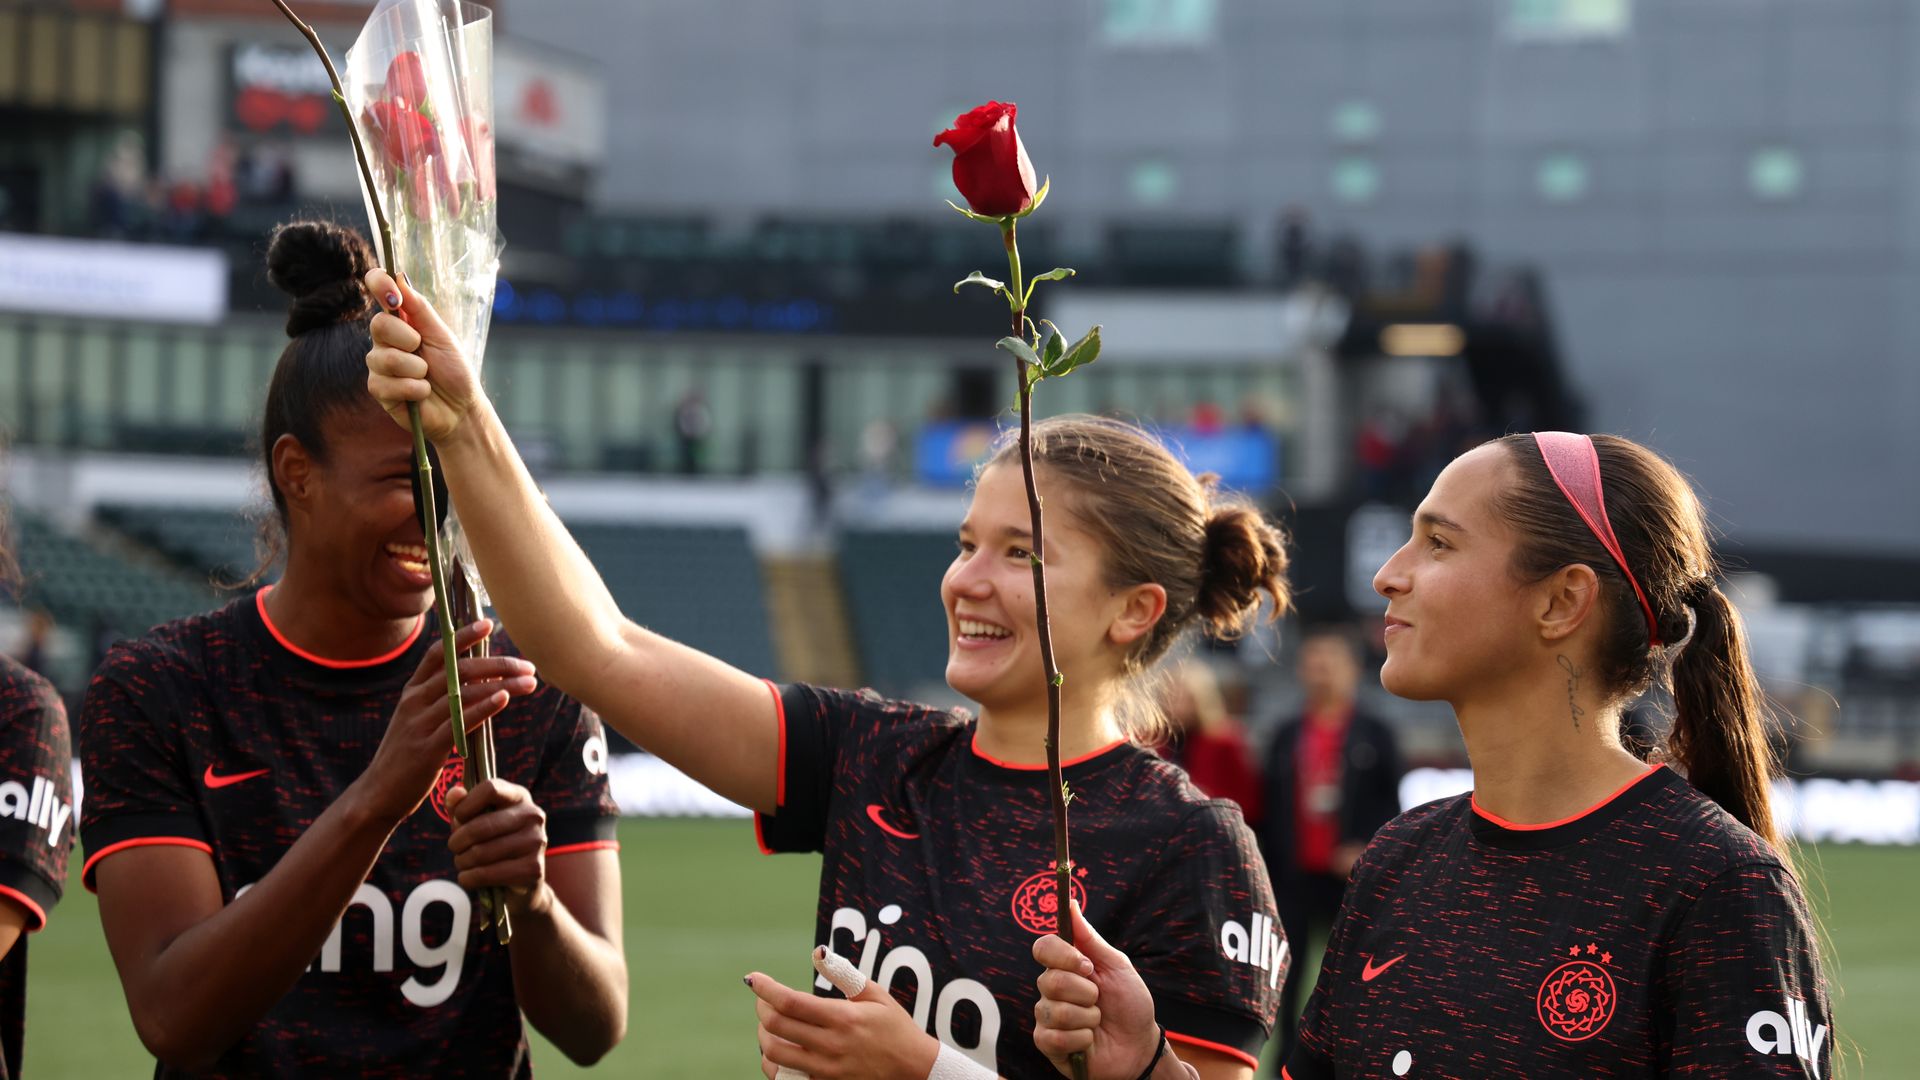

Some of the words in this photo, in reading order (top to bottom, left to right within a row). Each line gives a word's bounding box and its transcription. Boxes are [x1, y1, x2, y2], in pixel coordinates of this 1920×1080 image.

[0, 775, 72, 848] ally
[234, 879, 472, 1008] ng
[1221, 911, 1289, 990] ally
[1745, 996, 1827, 1080] ally
